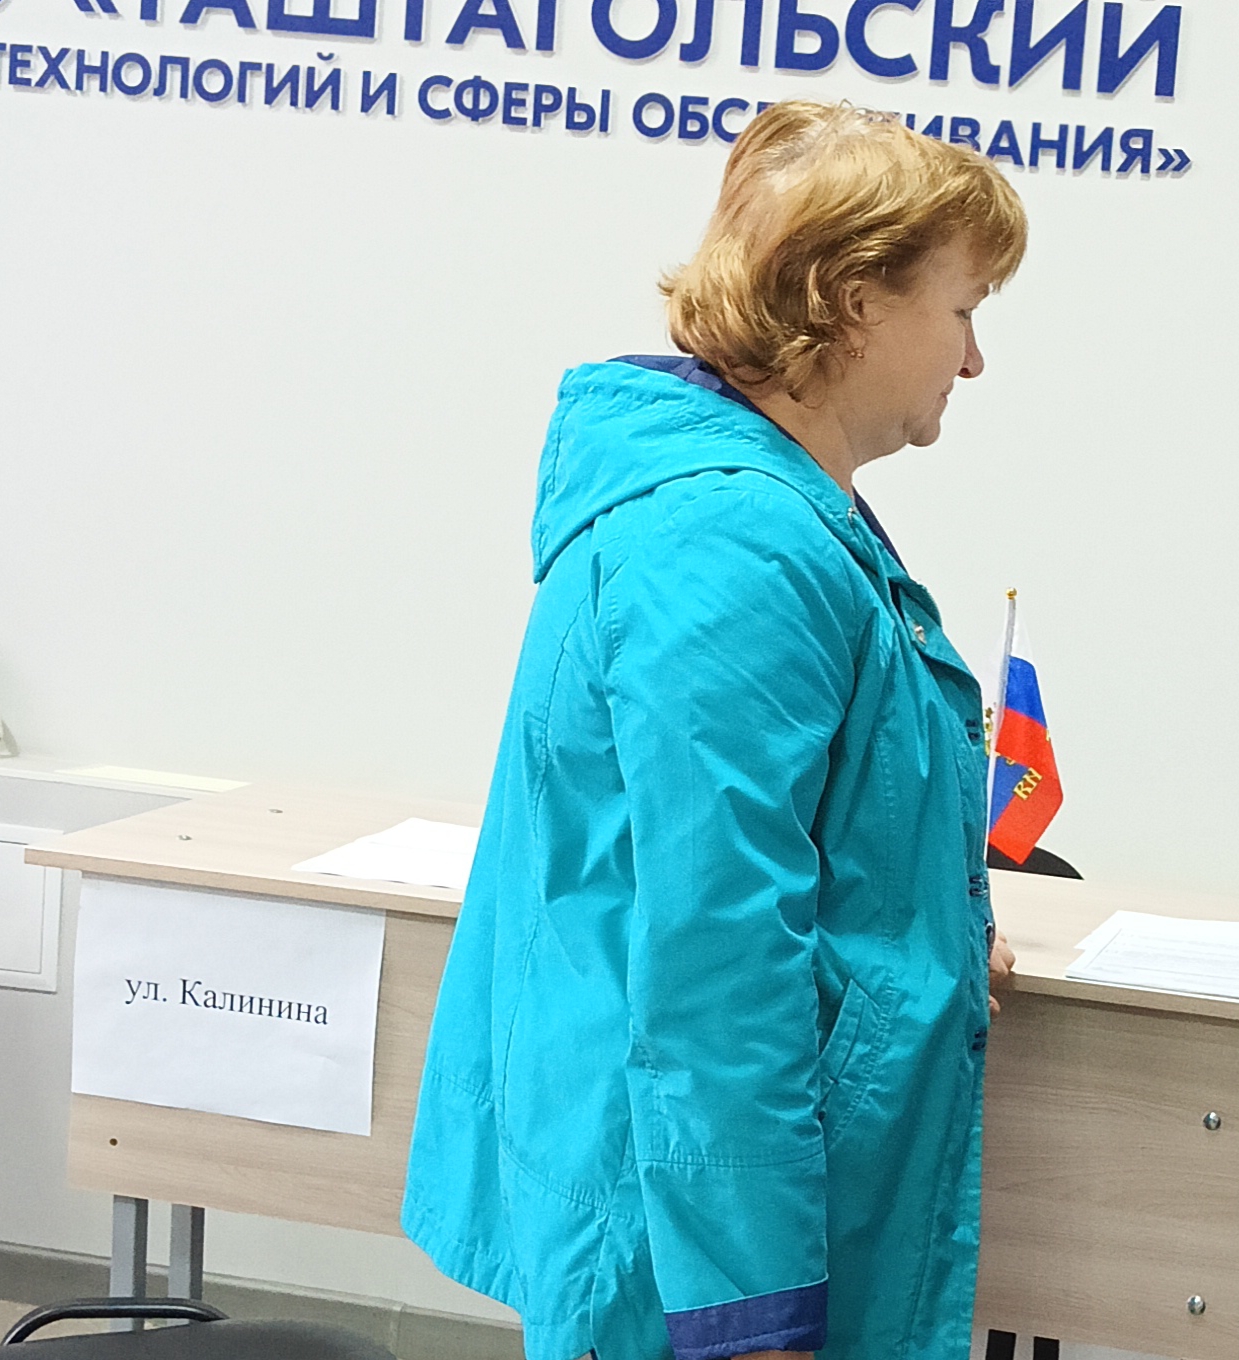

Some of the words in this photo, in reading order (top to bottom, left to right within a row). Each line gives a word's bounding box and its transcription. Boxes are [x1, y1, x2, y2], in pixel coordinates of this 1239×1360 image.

[0, 42, 342, 111] ЕХНОЛОГИЙ
[360, 70, 398, 116] И
[417, 75, 611, 133] СФЕРЫ
[632, 92, 1190, 174] ОБСВАНИЯ»
[124, 978, 167, 1005] ул.
[179, 977, 329, 1026] Калинина
